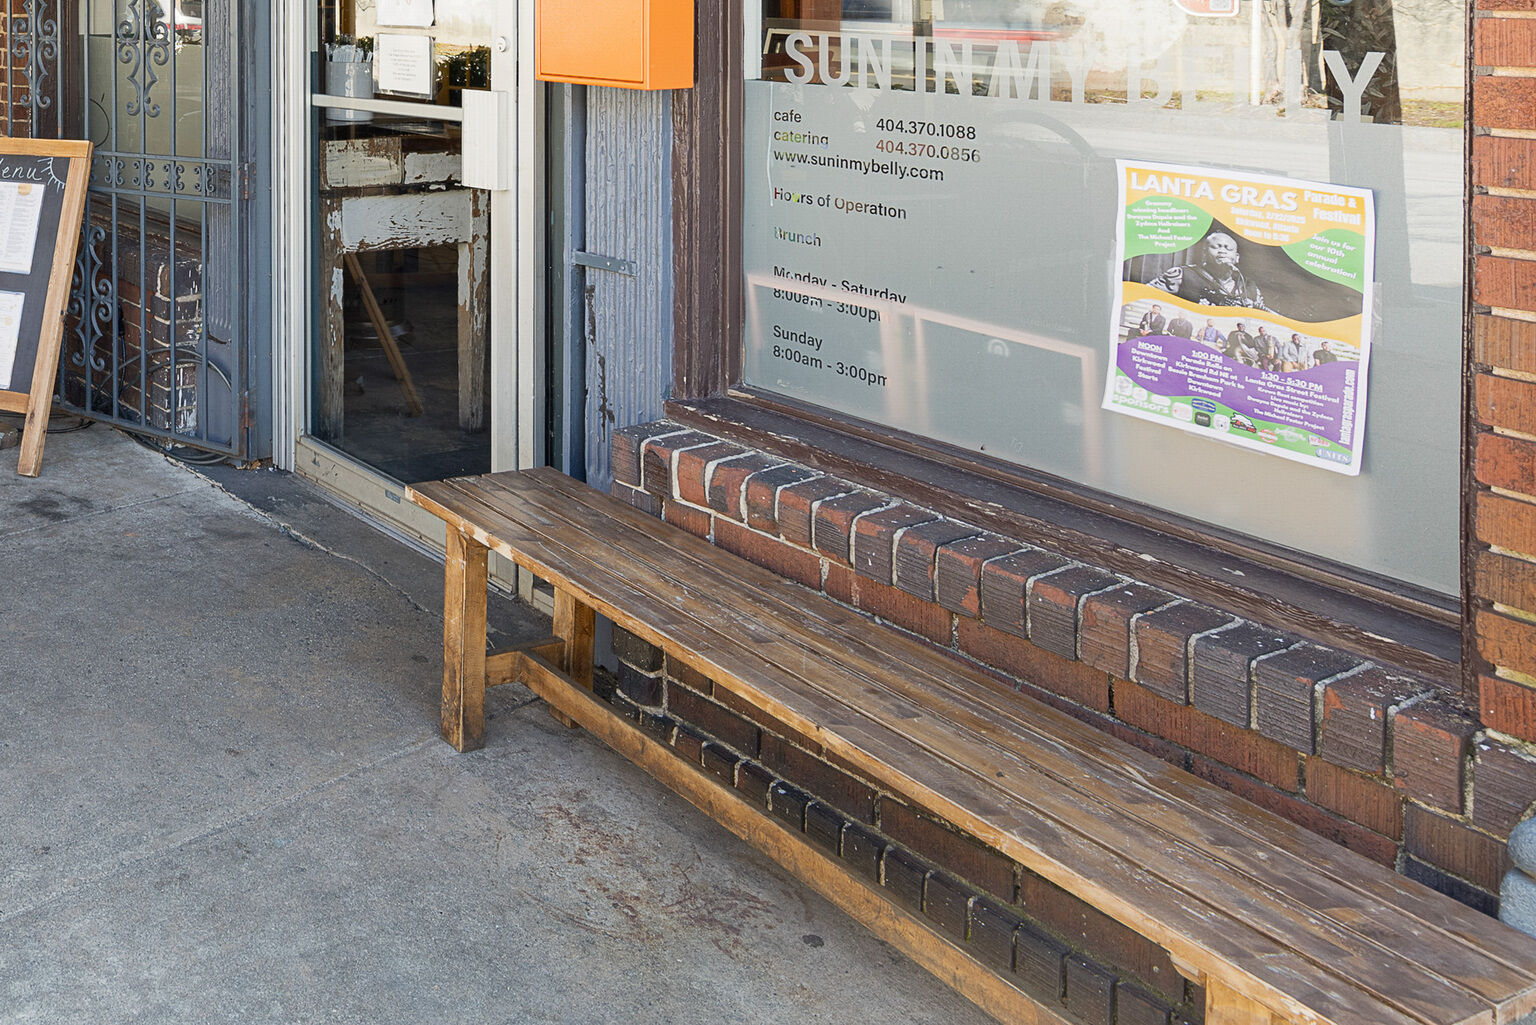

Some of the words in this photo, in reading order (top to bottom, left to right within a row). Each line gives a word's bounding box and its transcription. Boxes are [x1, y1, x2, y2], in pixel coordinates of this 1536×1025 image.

[783, 31, 892, 90] SUN
[914, 36, 973, 96] IN
[988, 39, 1100, 104] MY
[774, 109, 802, 123] cafe
[876, 118, 977, 140] 404.370.1088
[774, 130, 829, 150] catering
[876, 139, 982, 163] 404.370.0856
[774, 150, 944, 181] www.suninmybelly.com
[1131, 172, 1215, 200] LANTA
[1221, 184, 1298, 211] GRAS
[1304, 190, 1345, 206] Parade
[1348, 197, 1357, 208] &
[774, 187, 813, 205] Hours
[818, 194, 831, 208] of
[834, 198, 907, 220] Operation
[1313, 208, 1361, 225] Festival
[1309, 243, 1325, 251] our
[1326, 246, 1345, 257] 10th
[1311, 234, 1329, 244] Join
[1331, 240, 1341, 248] us
[1342, 242, 1356, 251] for
[1307, 251, 1338, 264] annual
[1305, 259, 1357, 279] celebration!
[774, 266, 827, 288] Monday
[841, 280, 906, 304] Saturday
[773, 325, 823, 351] Sunday
[1138, 341, 1162, 353] NOON
[773, 345, 823, 369] 8:00am
[1192, 350, 1208, 359] 1:00
[1210, 354, 1223, 363] PM
[1261, 372, 1279, 382] 1:30
[1286, 378, 1306, 388] 5:30
[1308, 383, 1323, 392] PM
